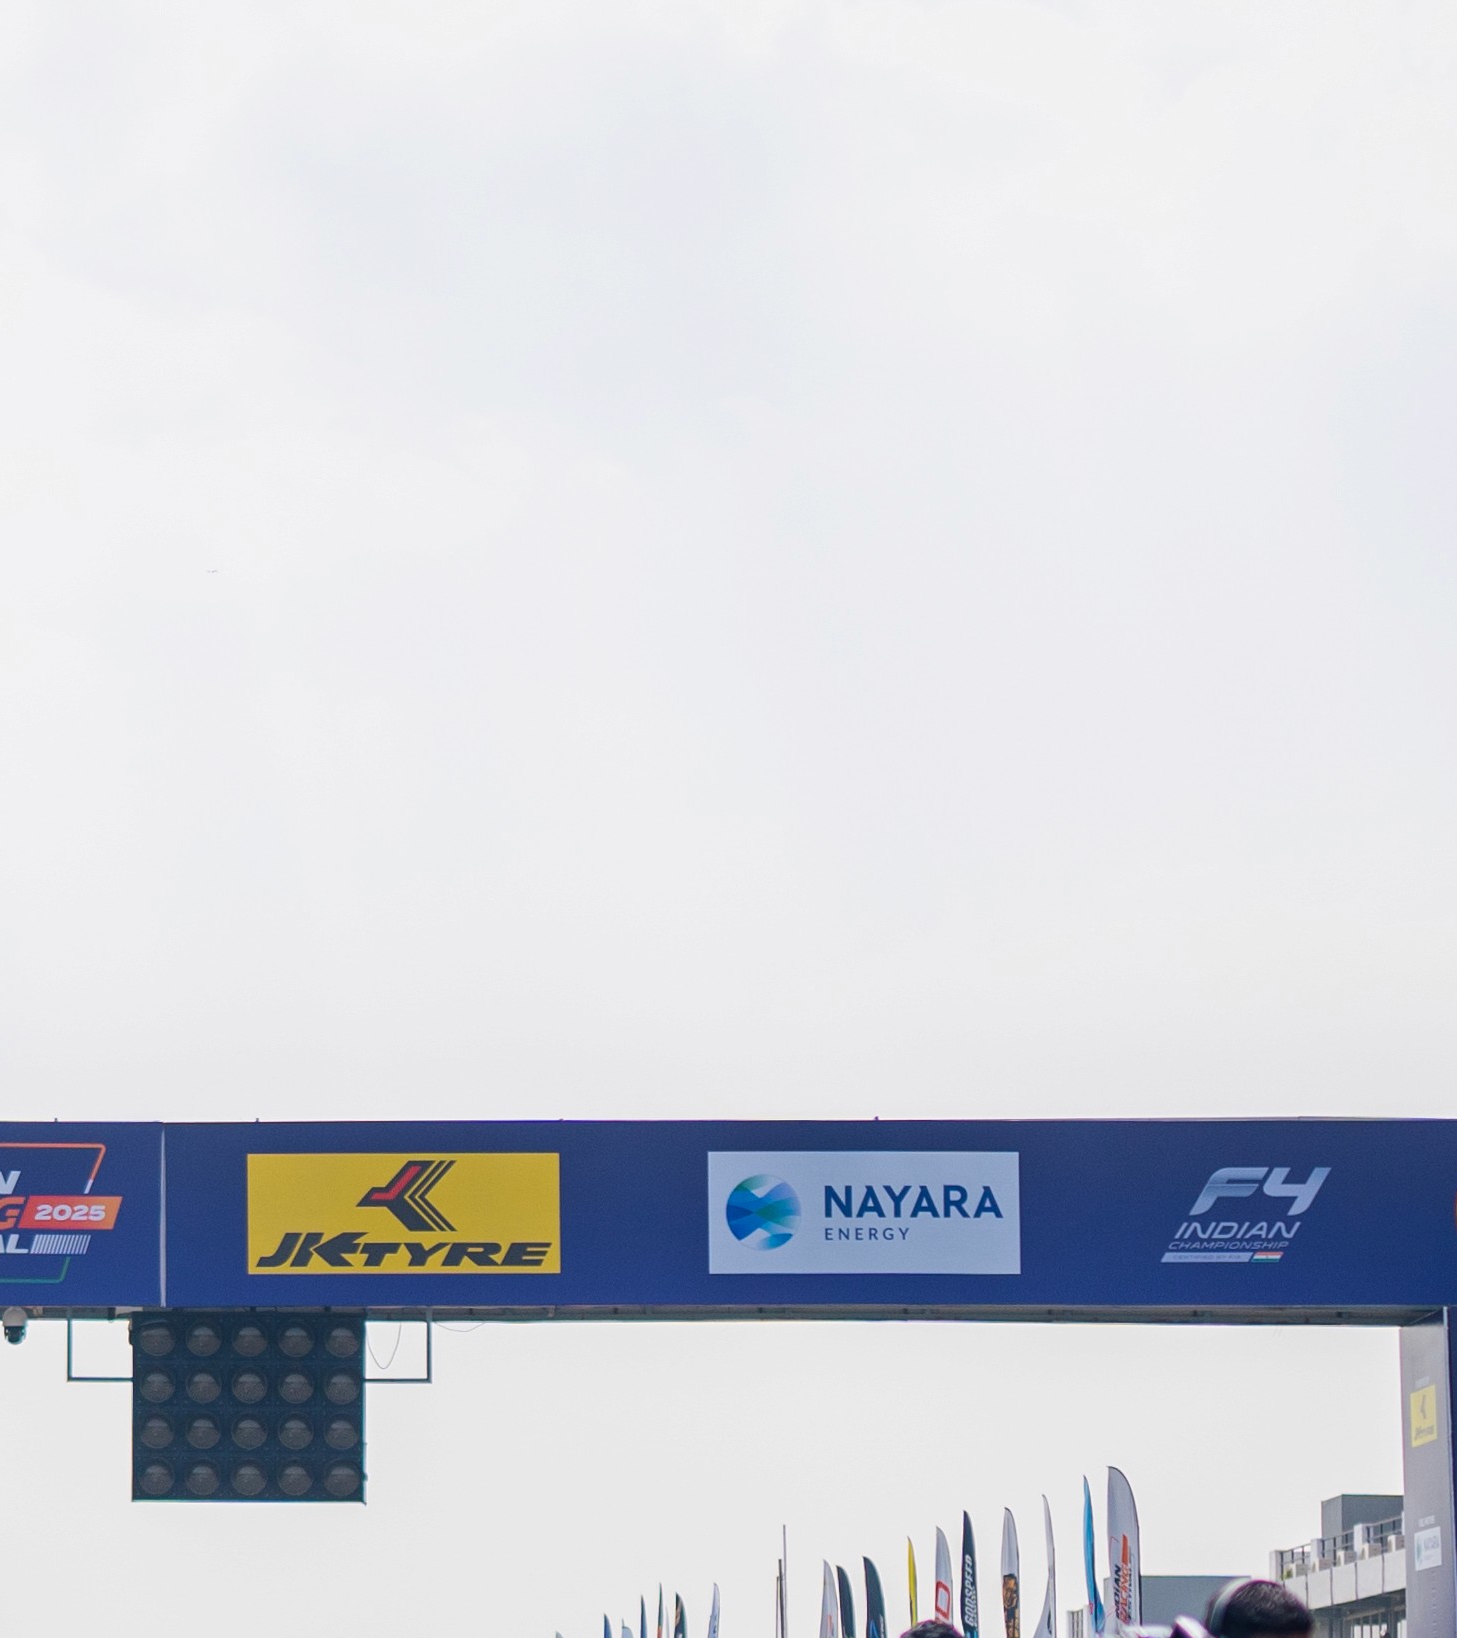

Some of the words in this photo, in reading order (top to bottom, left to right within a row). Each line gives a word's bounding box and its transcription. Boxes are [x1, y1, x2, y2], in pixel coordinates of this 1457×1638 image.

[1189, 1167, 1332, 1216] F4
[824, 1185, 1003, 1219] NAYARA
[34, 1203, 106, 1222] 2025
[824, 1227, 910, 1242] ENERGY
[1174, 1221, 1301, 1239] INDIAN
[1168, 1241, 1289, 1250] CHAMPIONSHIP
